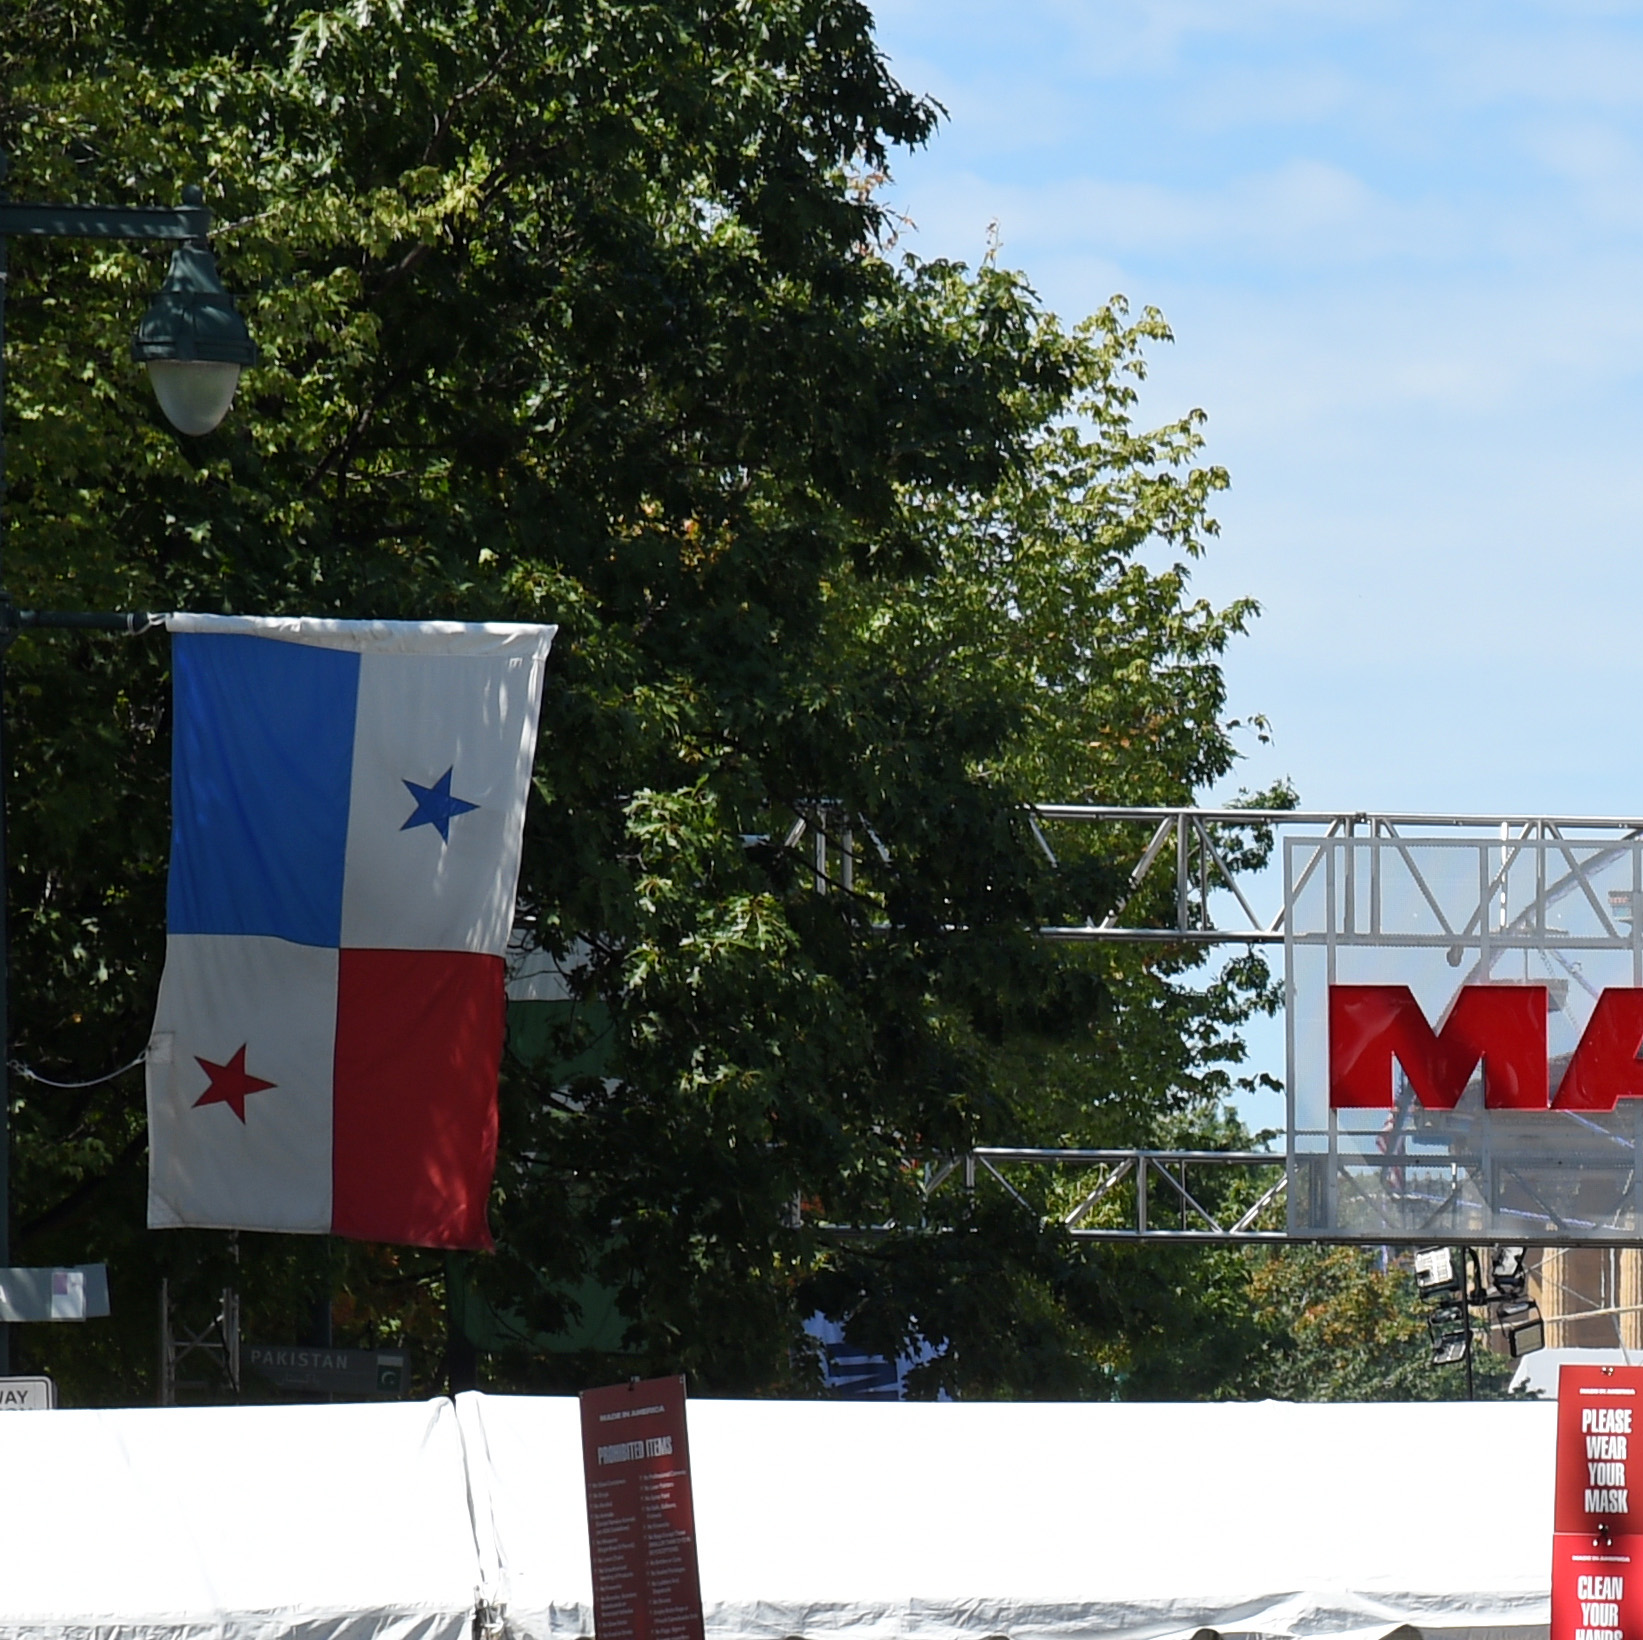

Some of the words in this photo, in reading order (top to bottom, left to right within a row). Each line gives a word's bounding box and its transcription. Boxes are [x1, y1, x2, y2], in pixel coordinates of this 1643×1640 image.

[250, 1350, 348, 1370] PAKISTAN
[1582, 1408, 1632, 1434] PLEASE
[646, 1436, 672, 1458] ITEMS
[1586, 1436, 1627, 1460] WEAR
[1588, 1462, 1625, 1486] YOUR
[1584, 1488, 1628, 1513] MASK
[1578, 1575, 1624, 1600] CLEAN
[1581, 1602, 1618, 1627] YOUR
